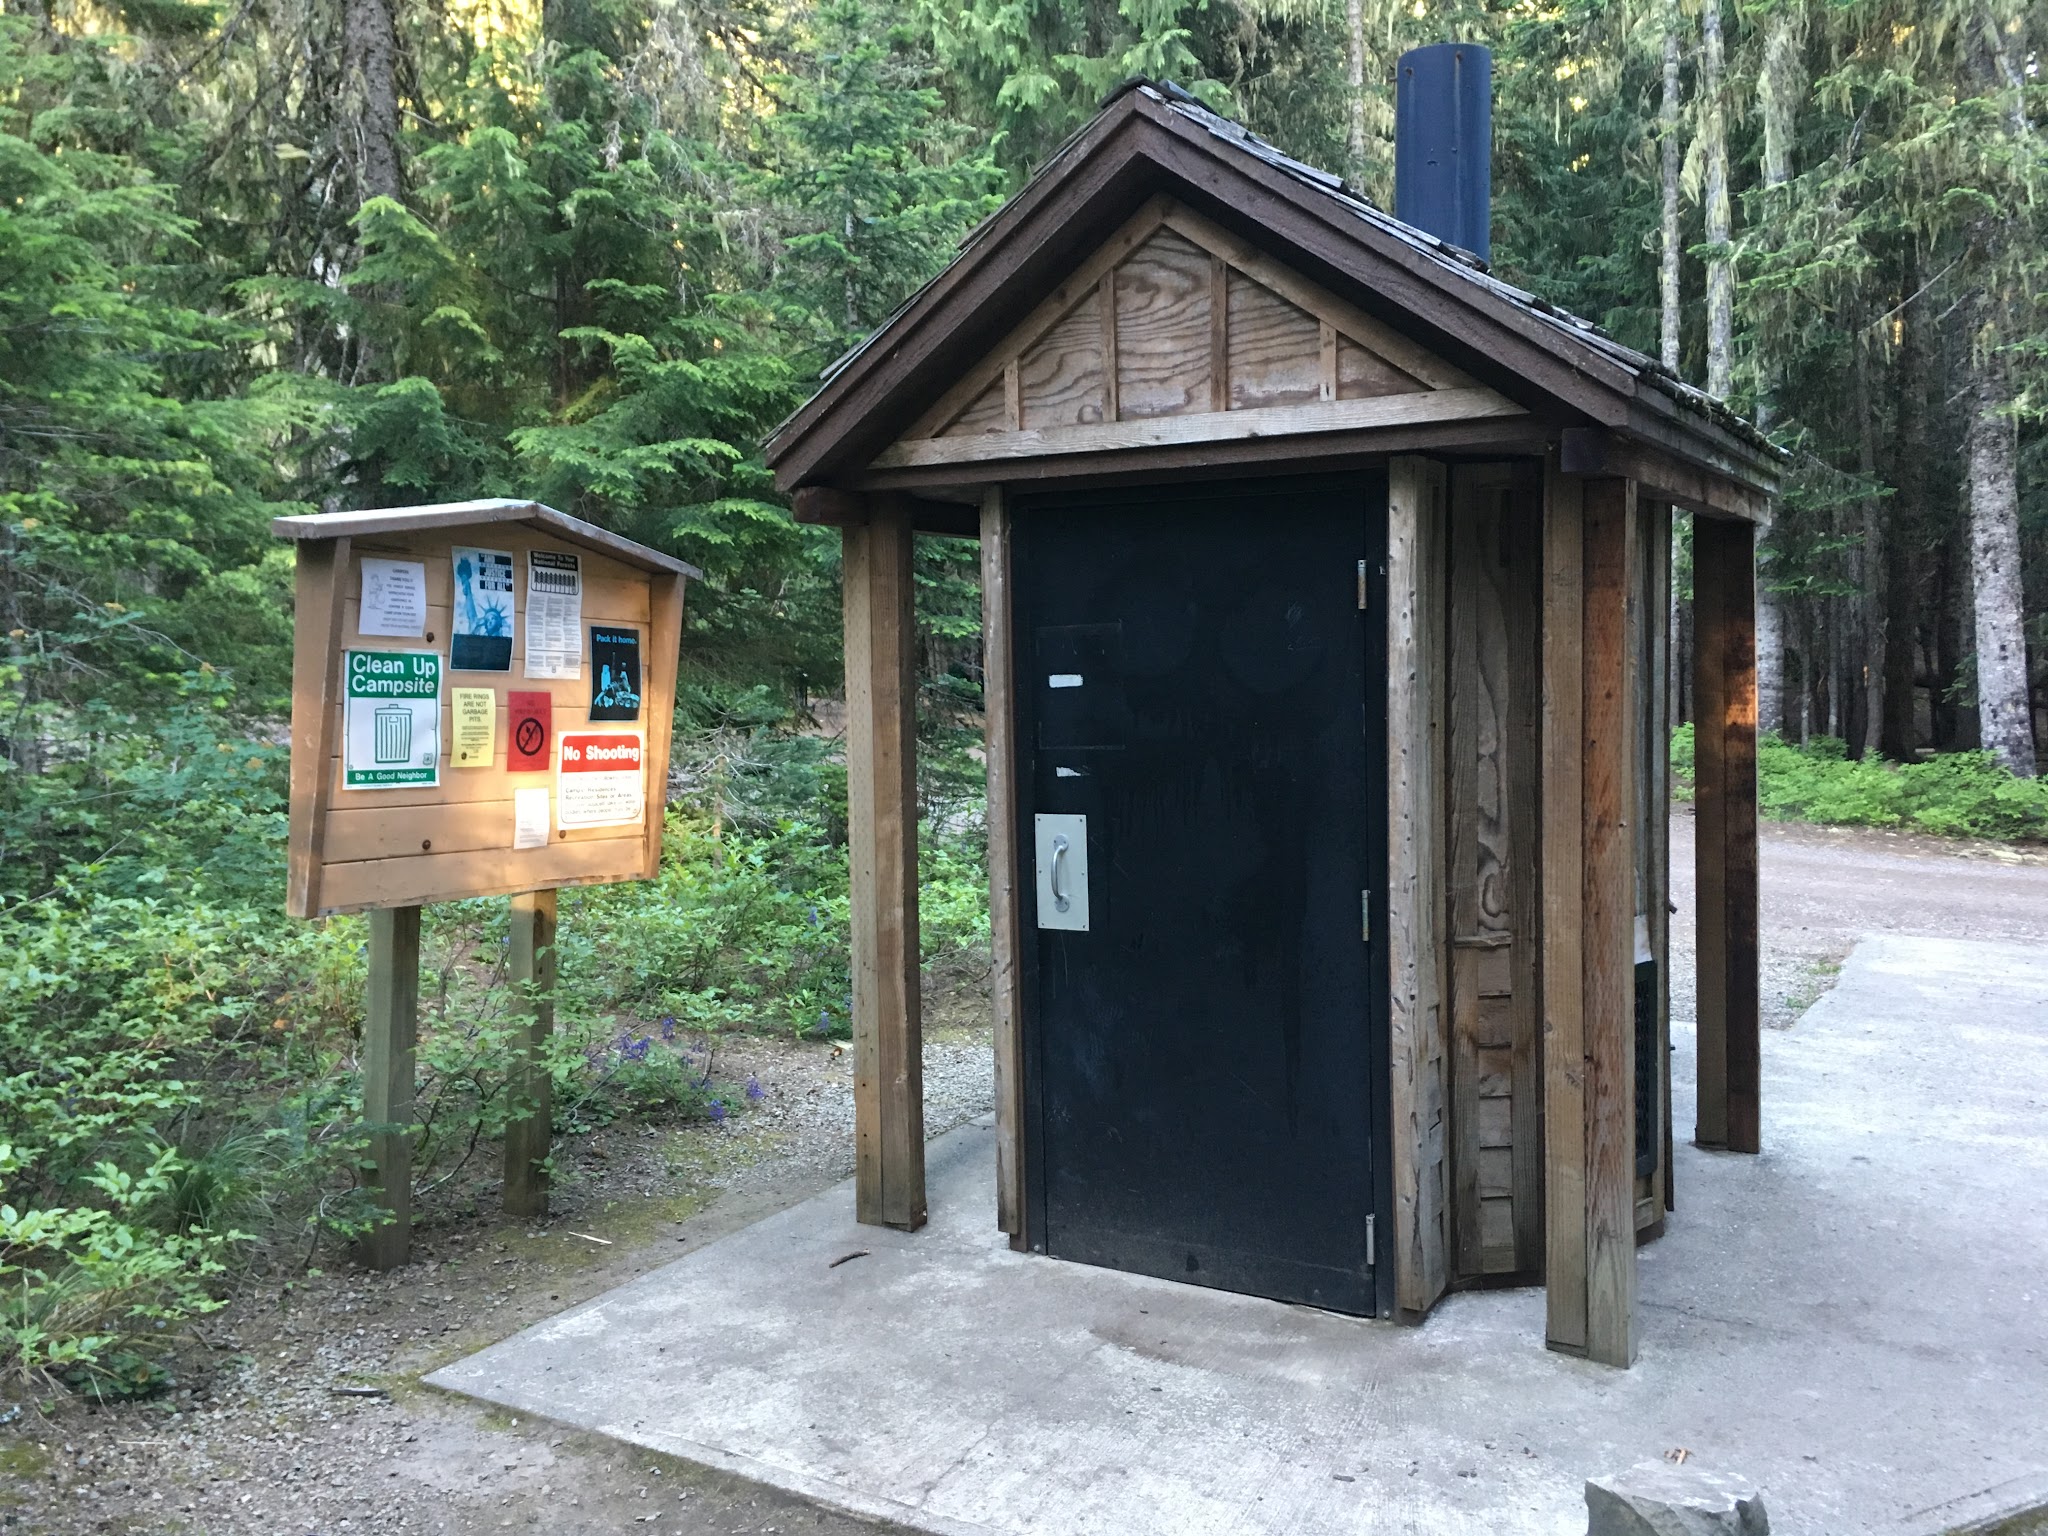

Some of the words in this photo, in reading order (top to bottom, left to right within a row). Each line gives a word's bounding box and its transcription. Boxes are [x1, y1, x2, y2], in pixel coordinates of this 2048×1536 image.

[533, 552, 556, 560] Welcome
[484, 567, 505, 578] JUSTICE
[485, 581, 495, 590] FOR
[596, 633, 611, 643] Pack
[612, 634, 617, 643] it
[352, 653, 405, 674] Clean
[412, 656, 436, 679] Up
[351, 674, 435, 696] Campsite
[563, 745, 581, 761] No
[586, 744, 640, 762] Shooting
[355, 772, 365, 781] Be
[376, 772, 395, 781] Good
[397, 771, 427, 781] Neighbor
